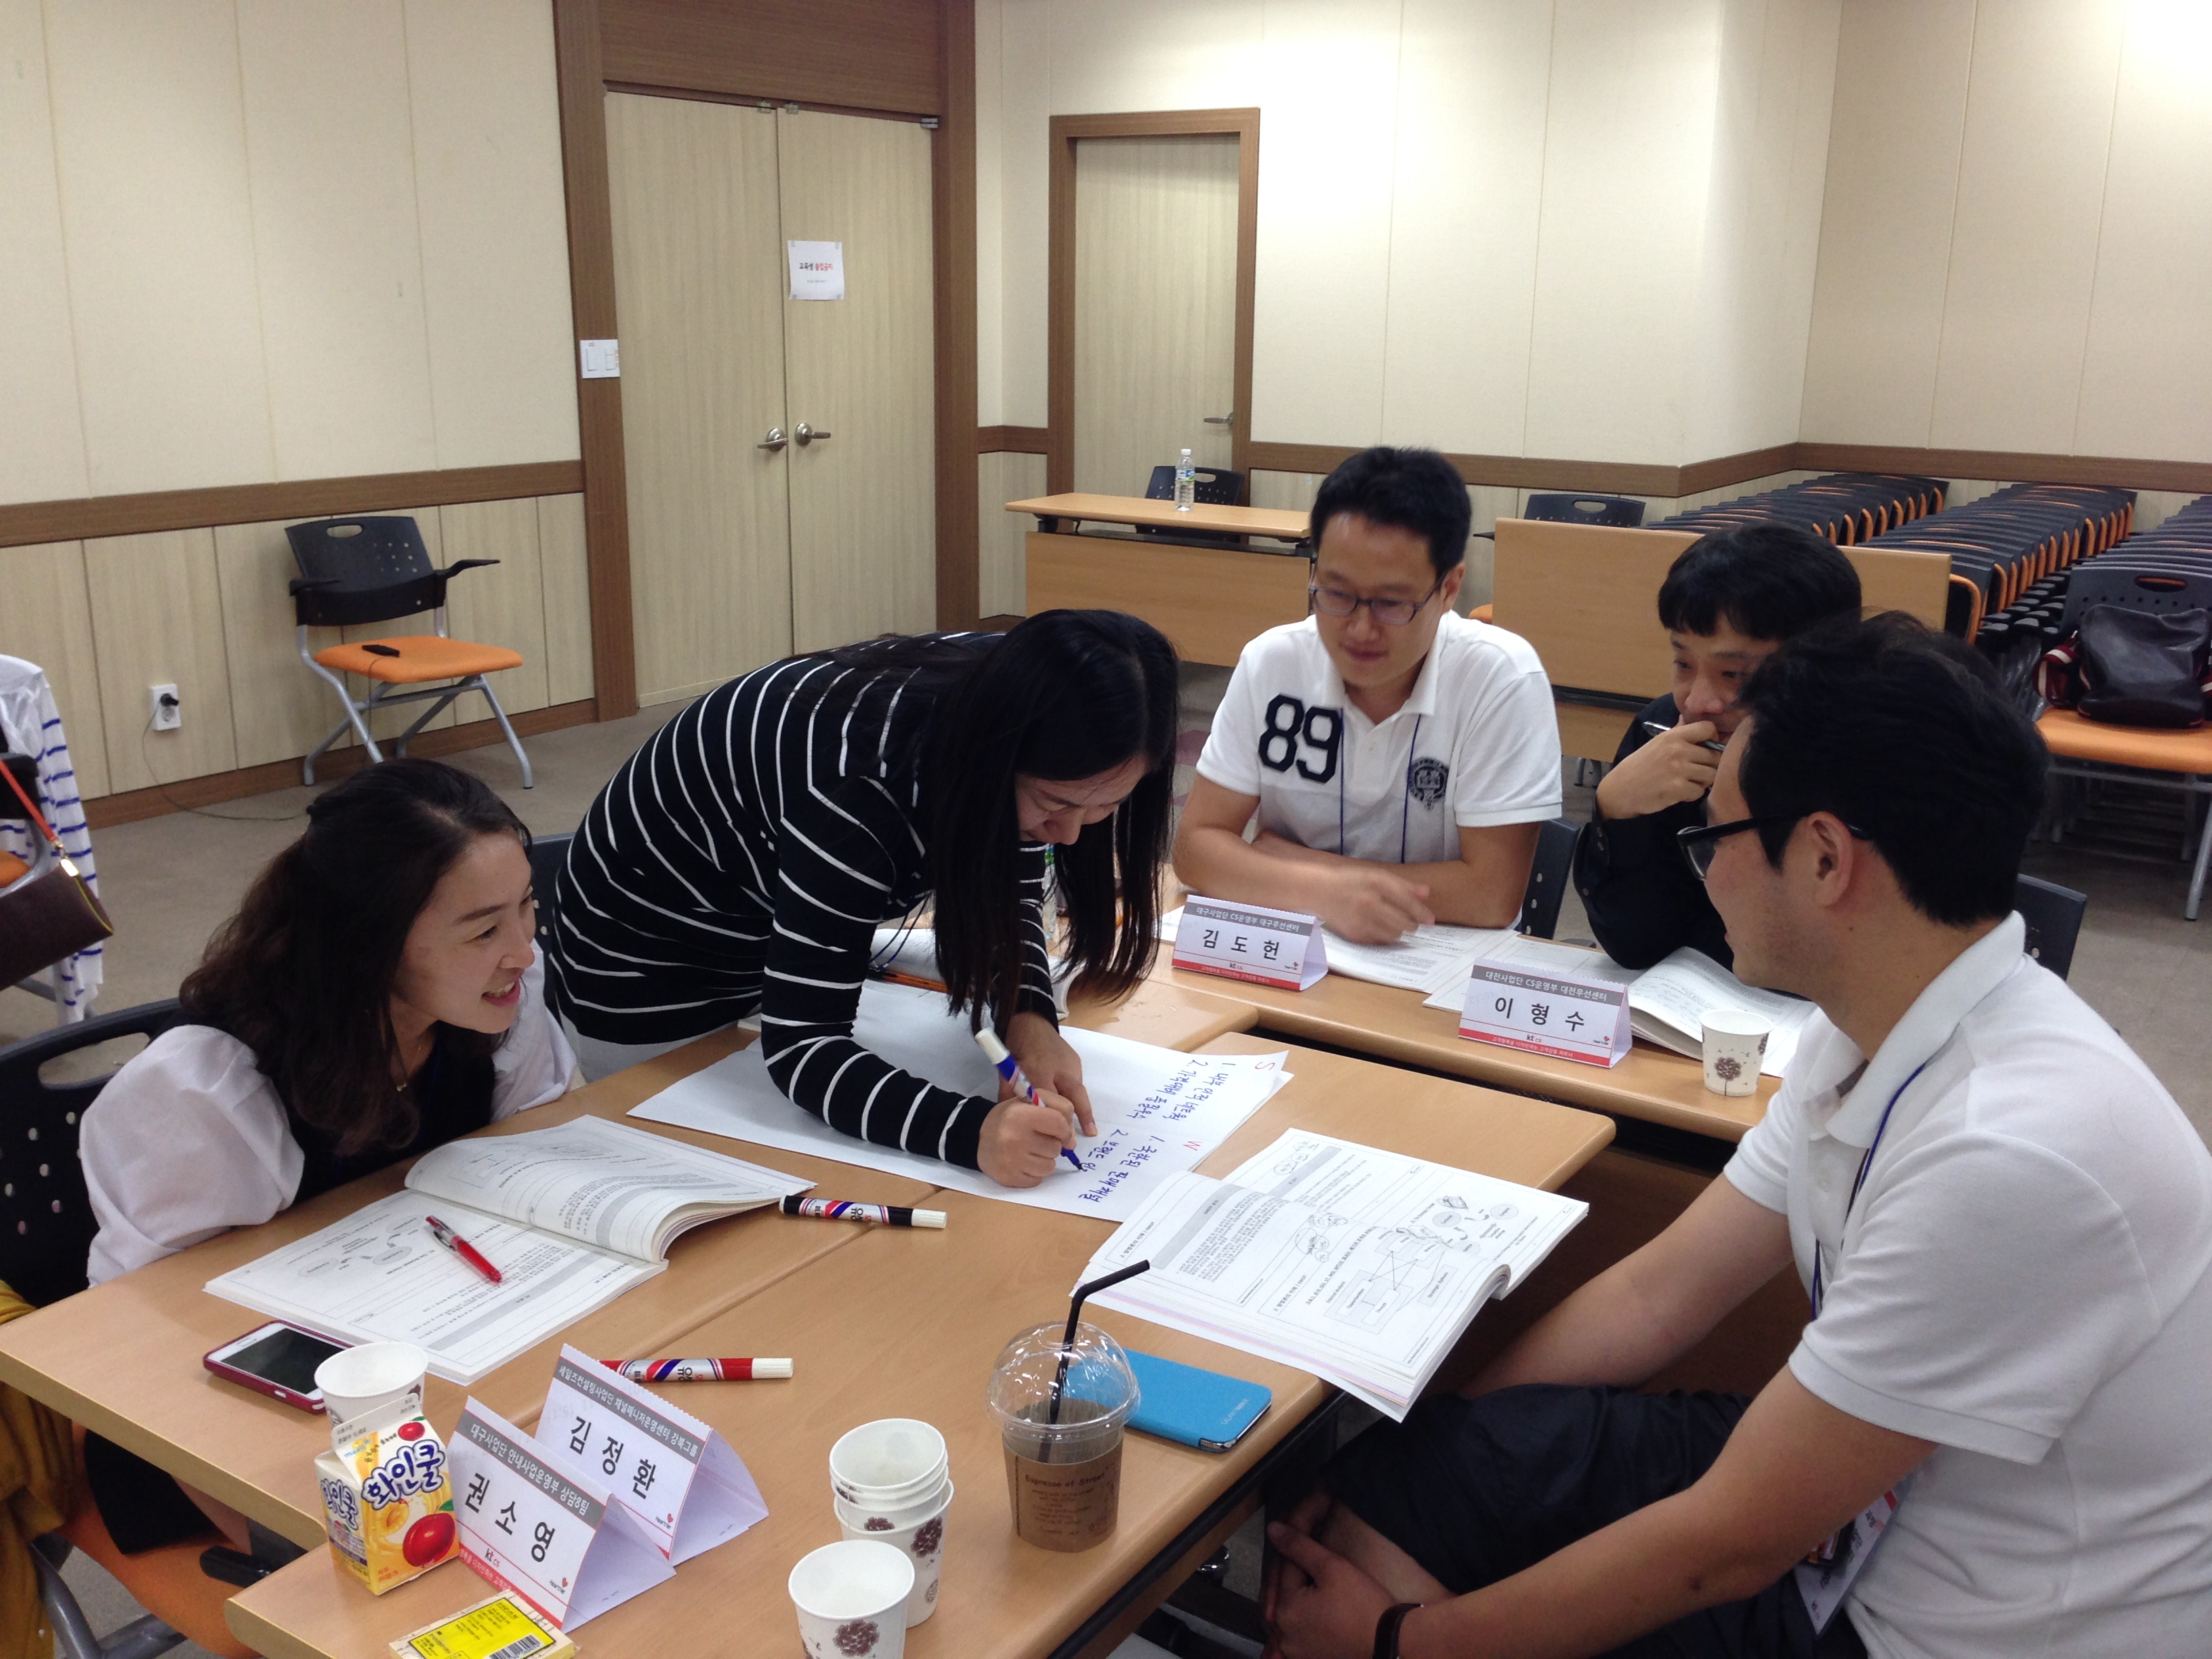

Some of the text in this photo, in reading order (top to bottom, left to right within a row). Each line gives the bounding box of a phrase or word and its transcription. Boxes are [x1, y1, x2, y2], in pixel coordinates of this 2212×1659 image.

[1258, 693, 1343, 784] 89
[1195, 907, 1300, 932] 대구사업단 CS운영부 대구무선센터
[1486, 971, 1524, 985] 대전사업단
[1525, 977, 1558, 991] CS운영부
[1560, 985, 1607, 1001] 대전무선센터
[1254, 1061, 1275, 1070] S
[1088, 1141, 1119, 1159] 브랜드
[363, 1441, 445, 1509] 화인쿨
[470, 1423, 590, 1516] 대구사업단 안내사업운영부 상담8팀
[1025, 1474, 1061, 1488] Espresso
[1065, 1479, 1075, 1488] of
